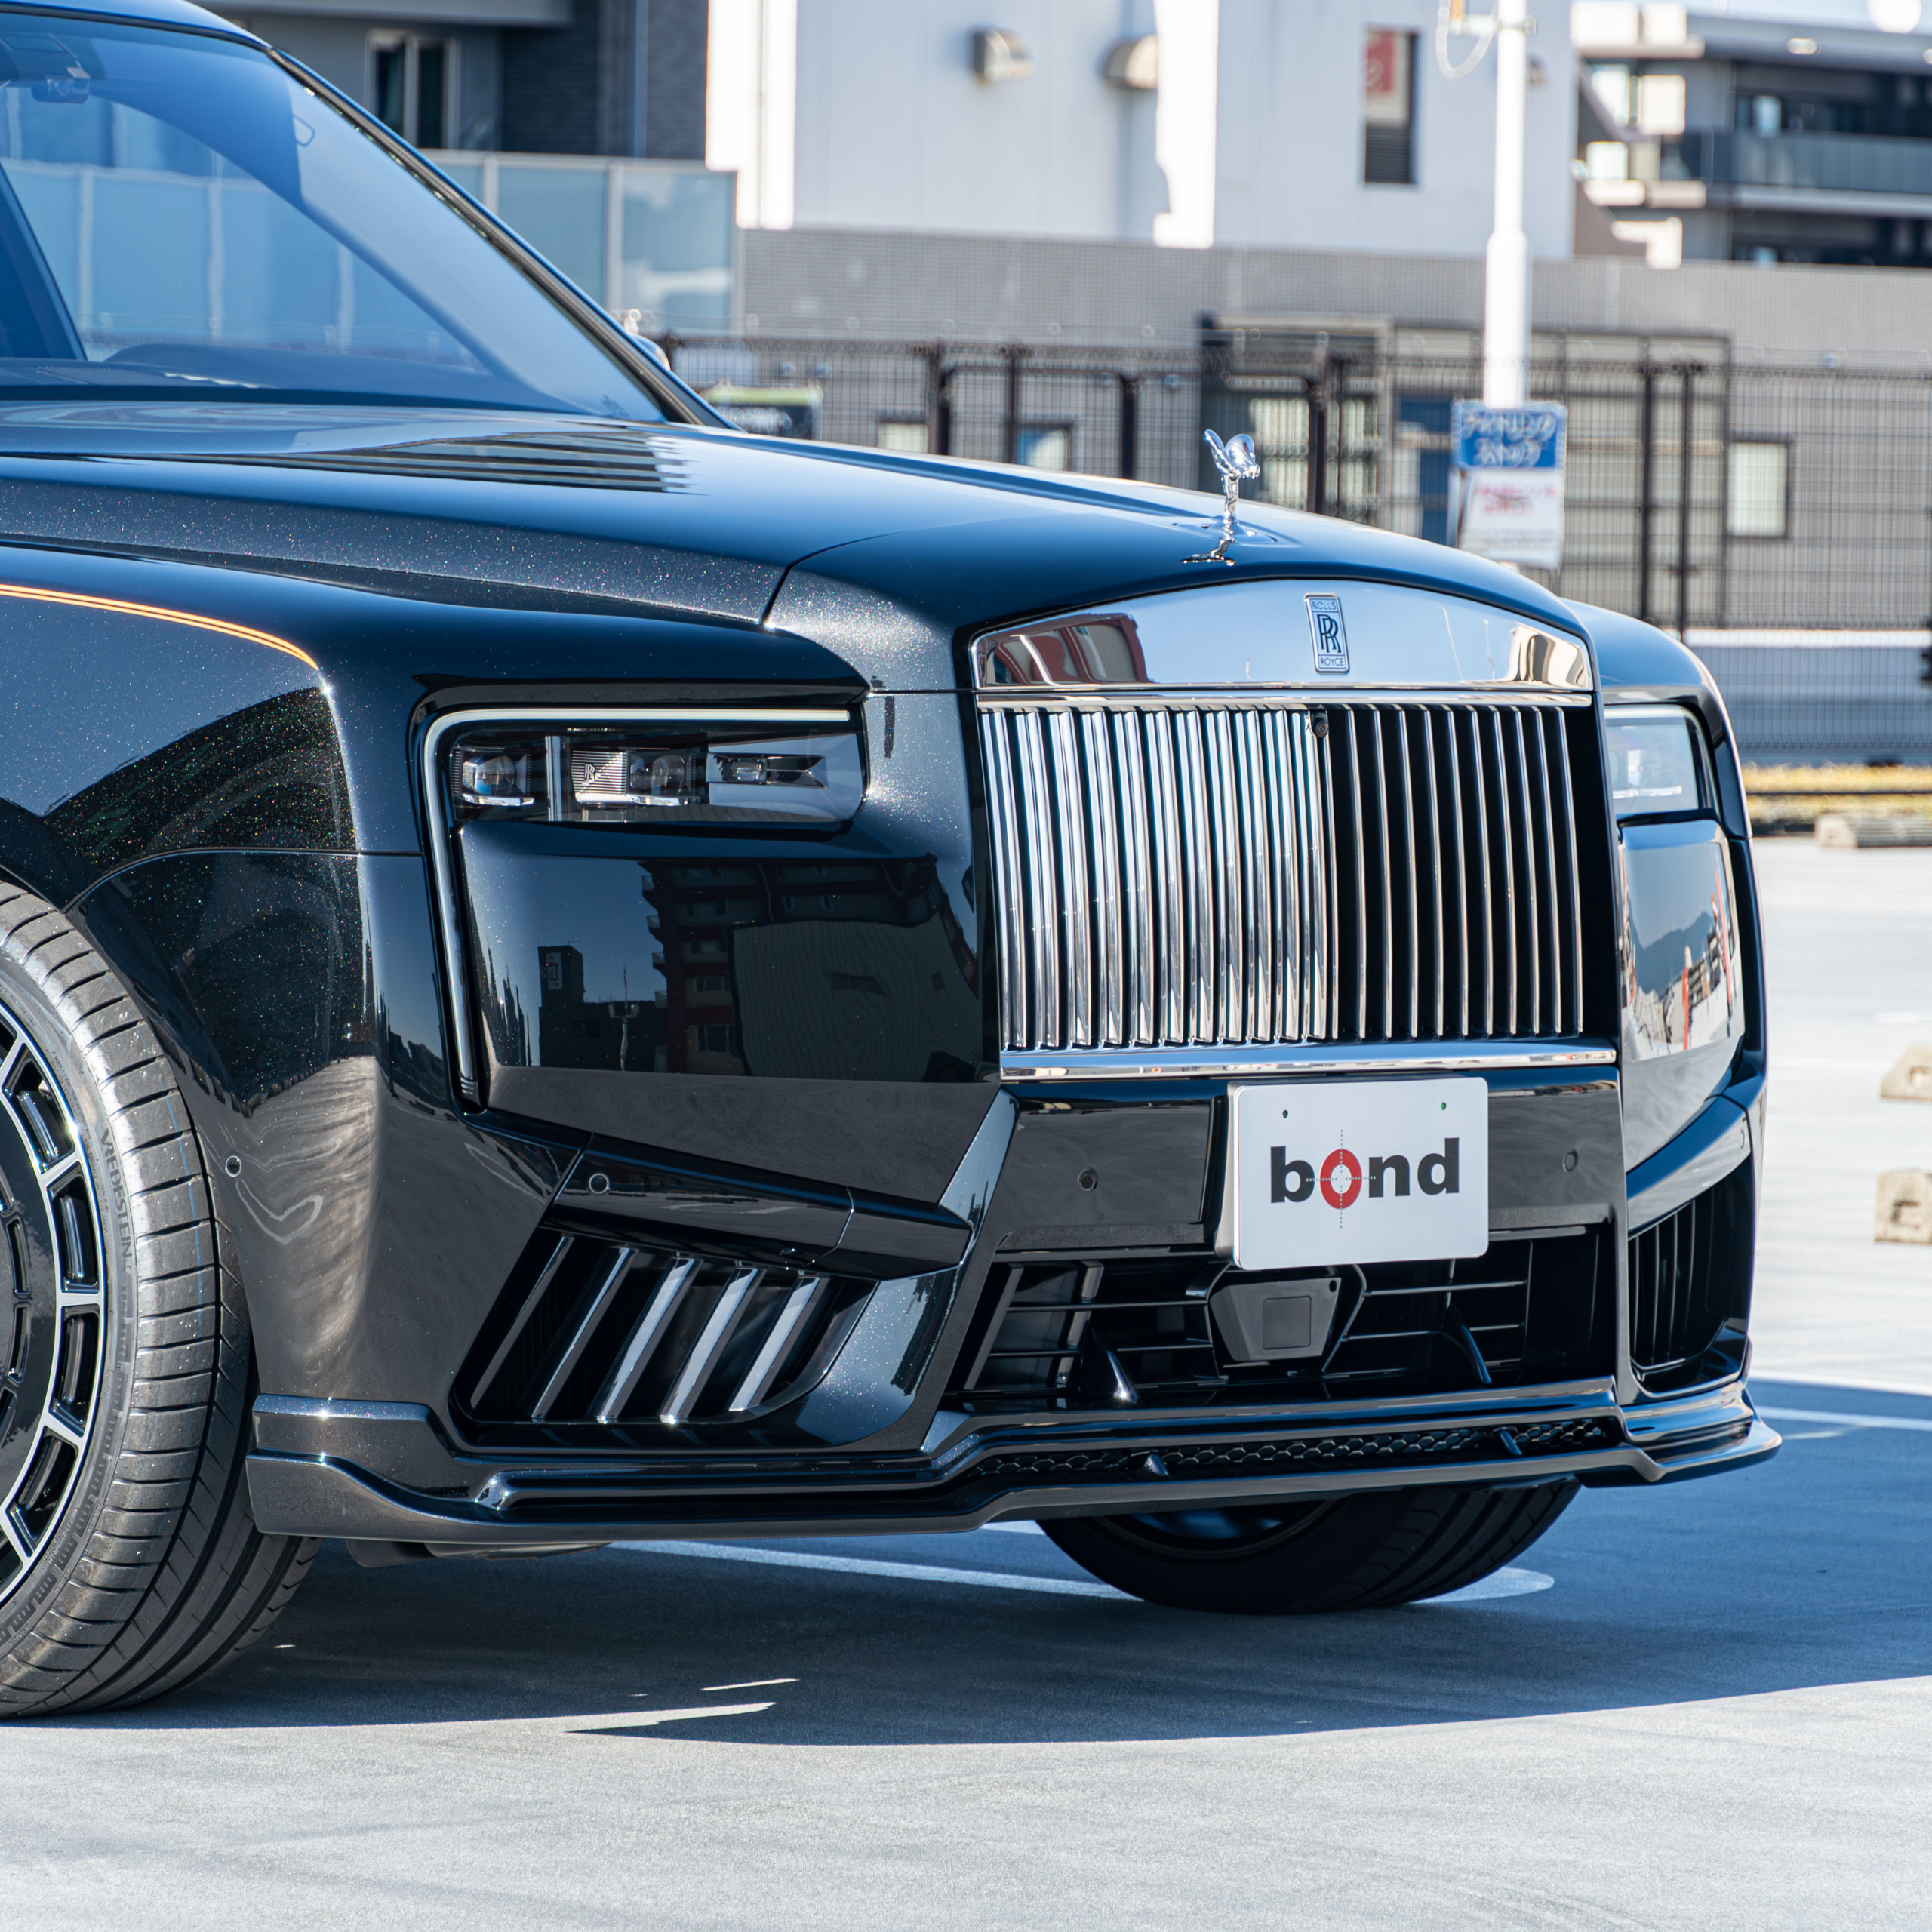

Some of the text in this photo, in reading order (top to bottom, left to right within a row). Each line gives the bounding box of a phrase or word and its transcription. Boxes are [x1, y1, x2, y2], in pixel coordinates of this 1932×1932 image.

[1312, 601, 1337, 610] ROLLS
[1320, 657, 1345, 666] ROYCE
[100, 1128, 133, 1259] VREDESTEIN
[1270, 1137, 1460, 1210] bond
